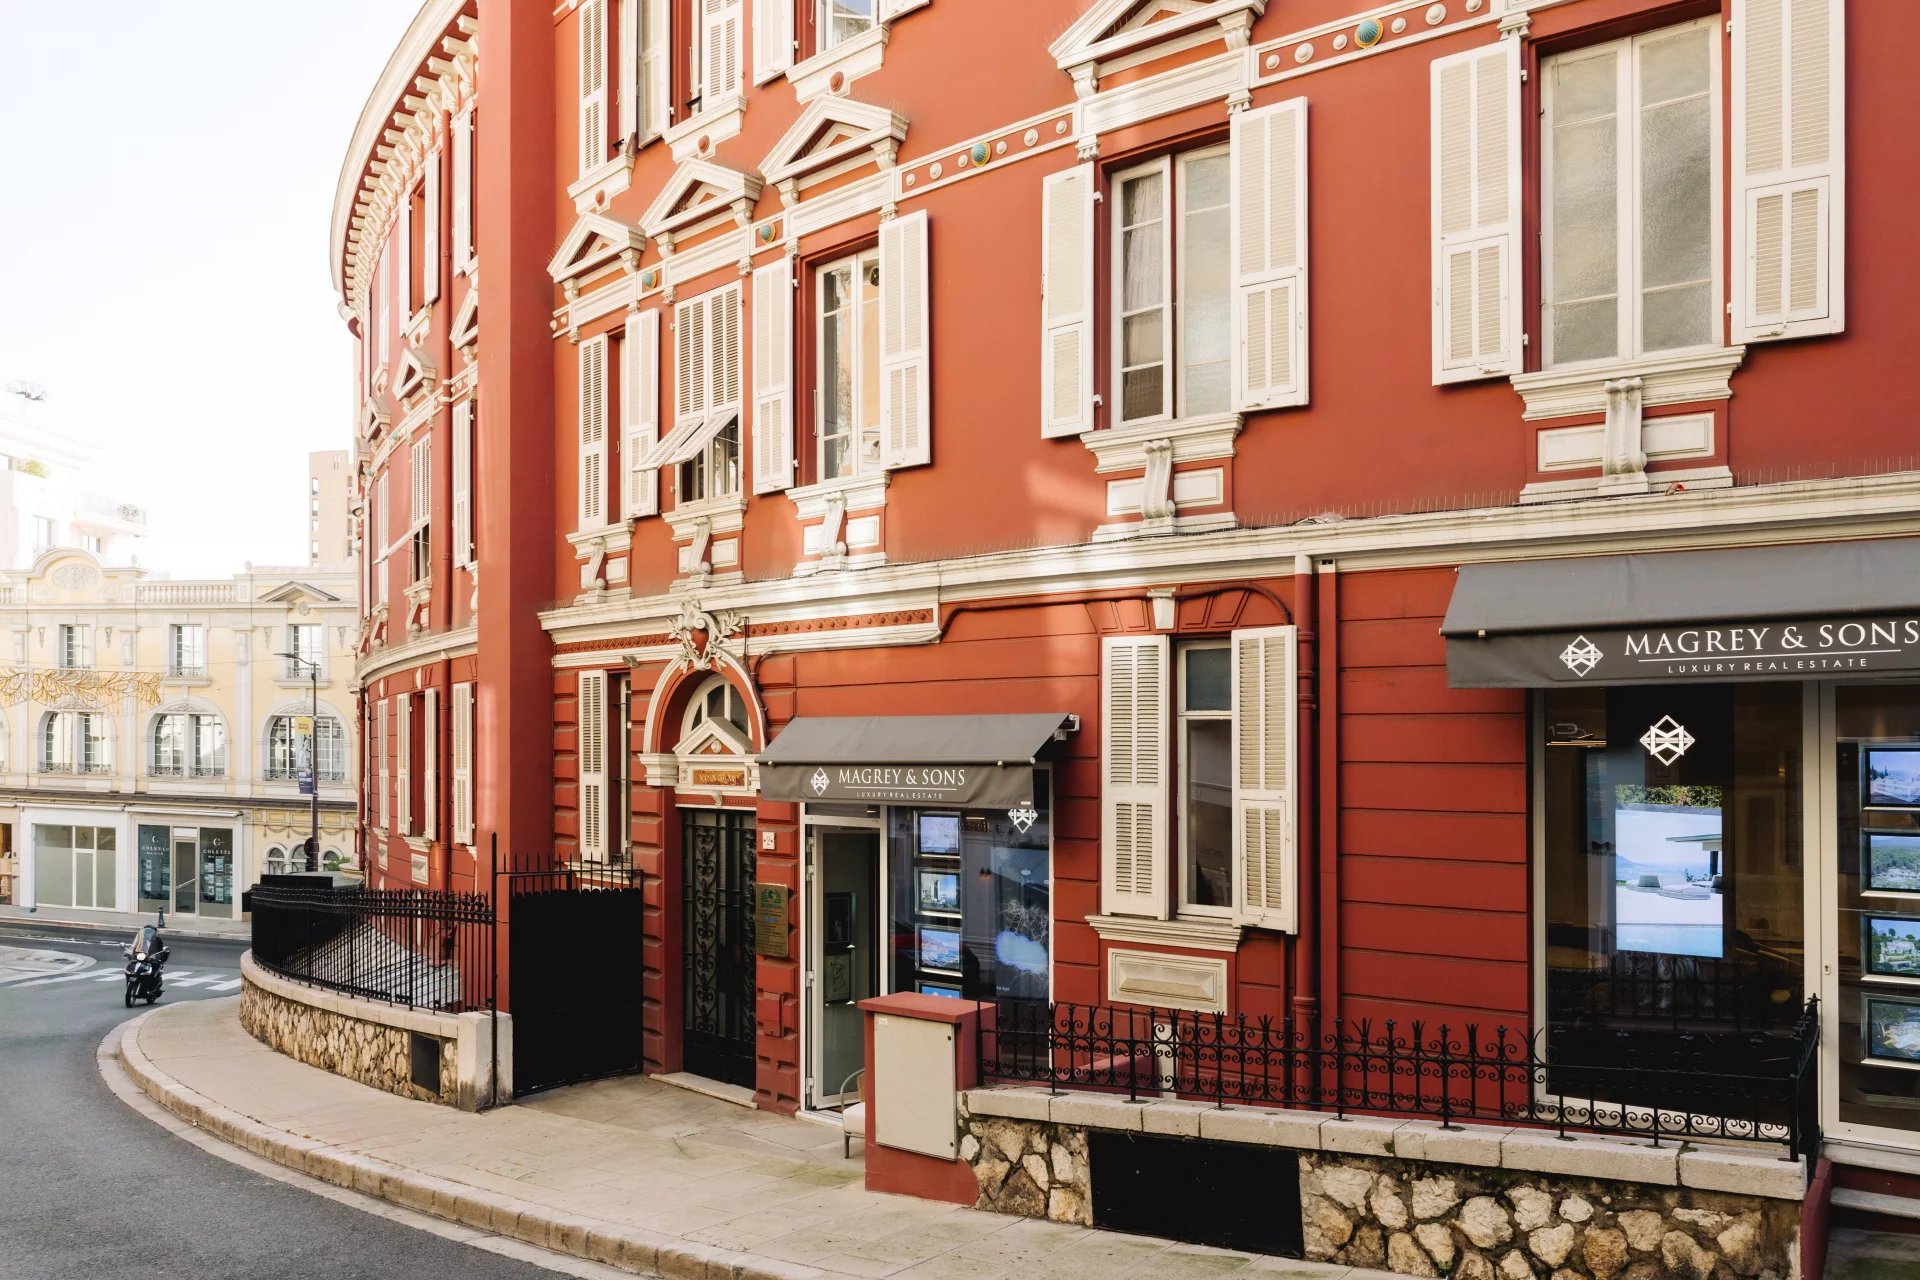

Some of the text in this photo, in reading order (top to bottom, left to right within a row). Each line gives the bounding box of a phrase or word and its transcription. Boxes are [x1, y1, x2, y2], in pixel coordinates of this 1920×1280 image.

[1624, 620, 1920, 656] MAGREY & SONS
[1668, 658, 1868, 674] LUXURY REAL ESTATE
[838, 768, 966, 786] MAGREY & SONS
